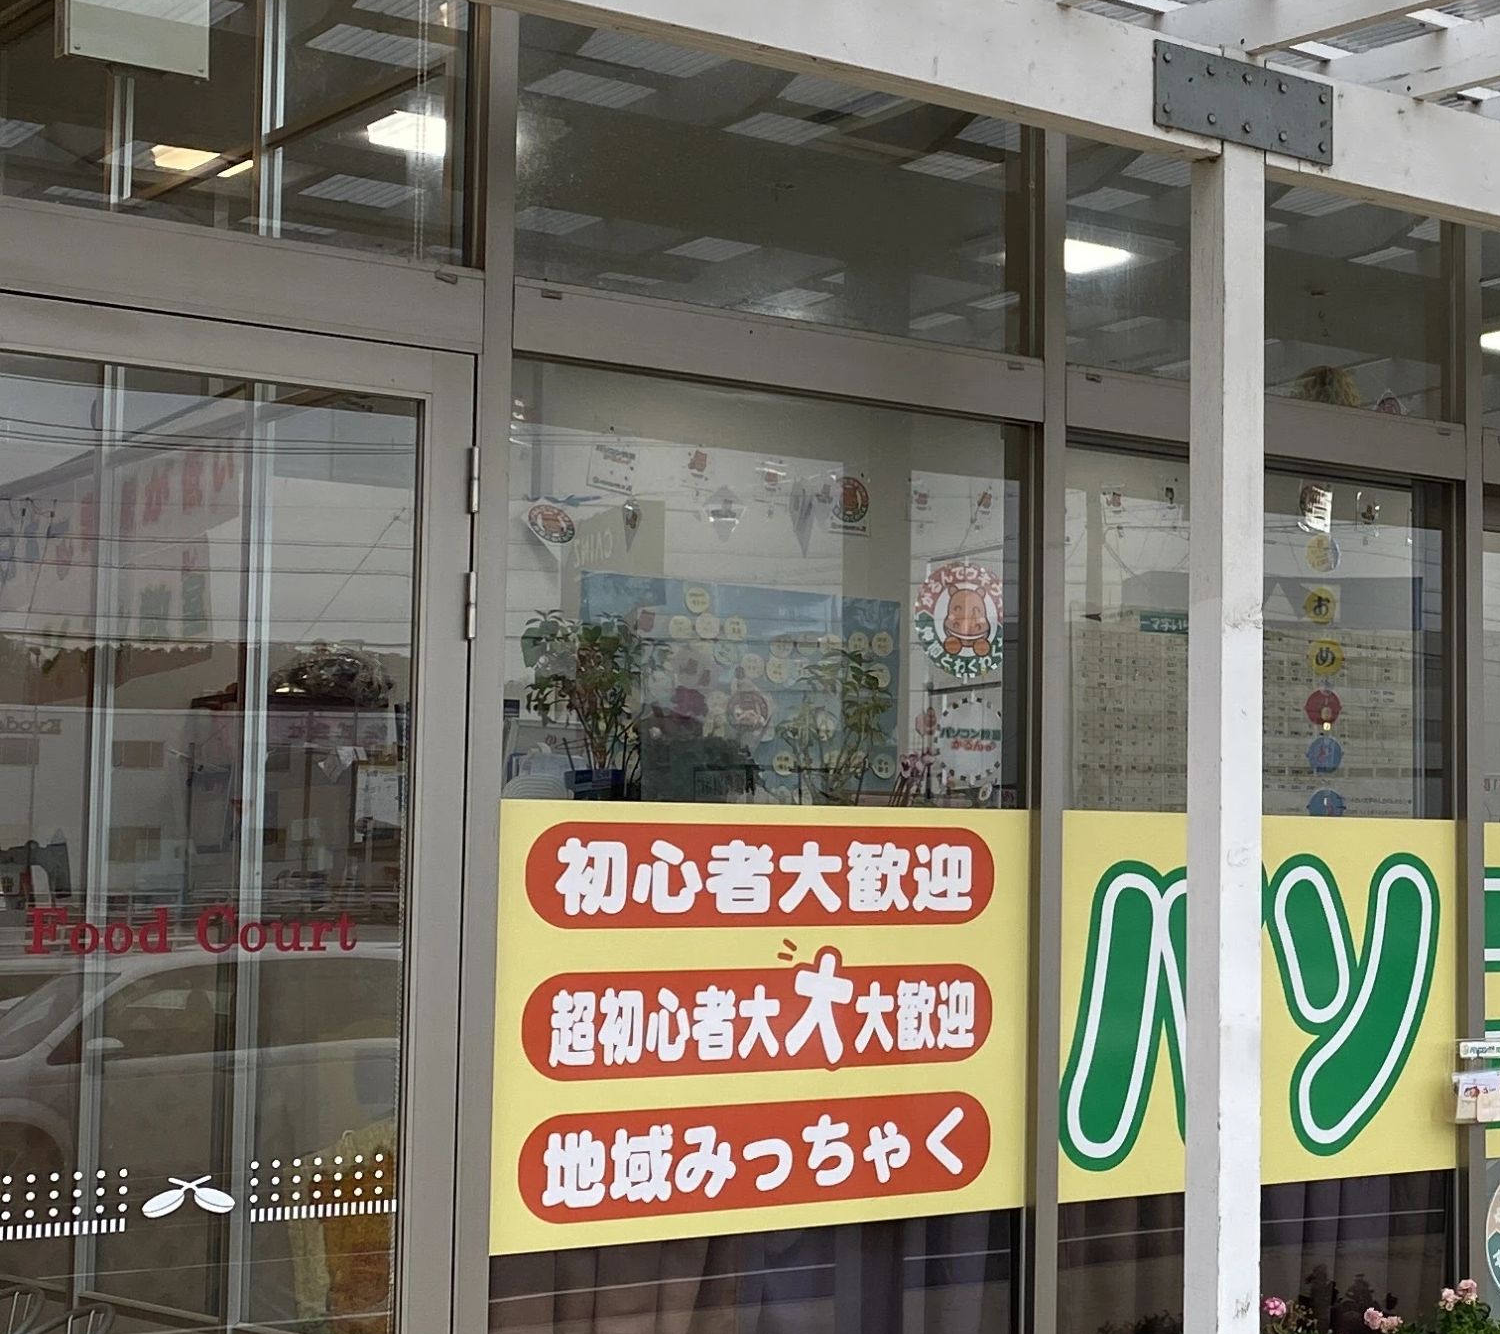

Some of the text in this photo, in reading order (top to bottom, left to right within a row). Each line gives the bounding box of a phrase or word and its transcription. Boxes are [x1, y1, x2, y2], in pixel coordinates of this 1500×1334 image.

[555, 837, 973, 916] 初心者大歓迎
[25, 905, 358, 955] Food Court
[548, 953, 975, 1069] 超初心者大大大歓迎
[541, 1106, 964, 1209] 地域みっちゃく
